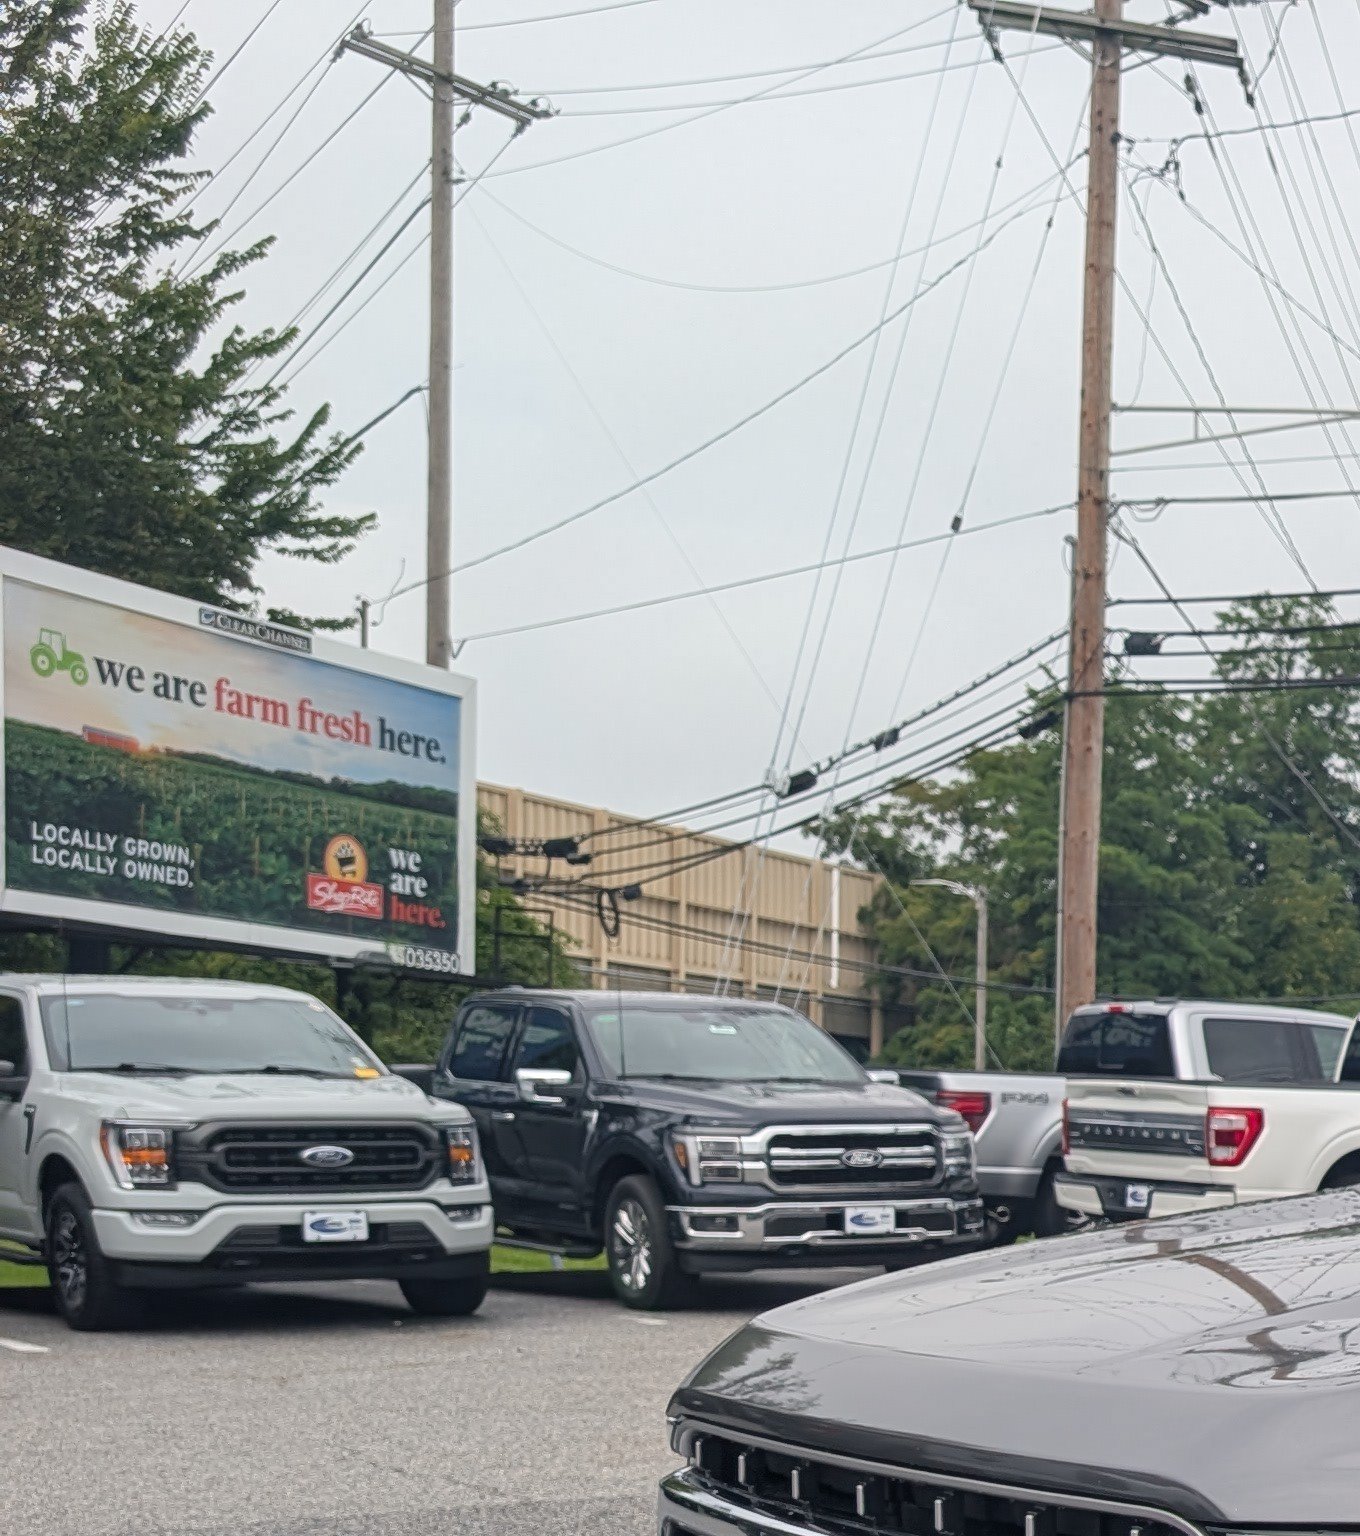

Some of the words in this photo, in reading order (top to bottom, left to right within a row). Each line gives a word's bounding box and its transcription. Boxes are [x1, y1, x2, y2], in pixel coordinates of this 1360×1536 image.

[92, 655, 146, 693] we
[152, 670, 208, 708] are
[214, 676, 290, 728] farm
[297, 697, 372, 746] fresh
[377, 715, 447, 764] here.
[31, 820, 118, 853] LOCALLY
[123, 836, 196, 869] GROWN,
[388, 847, 422, 873] we
[31, 844, 118, 876] LOCALLY
[123, 859, 194, 888] OWNED.
[389, 872, 428, 898] are
[390, 894, 447, 928] here.
